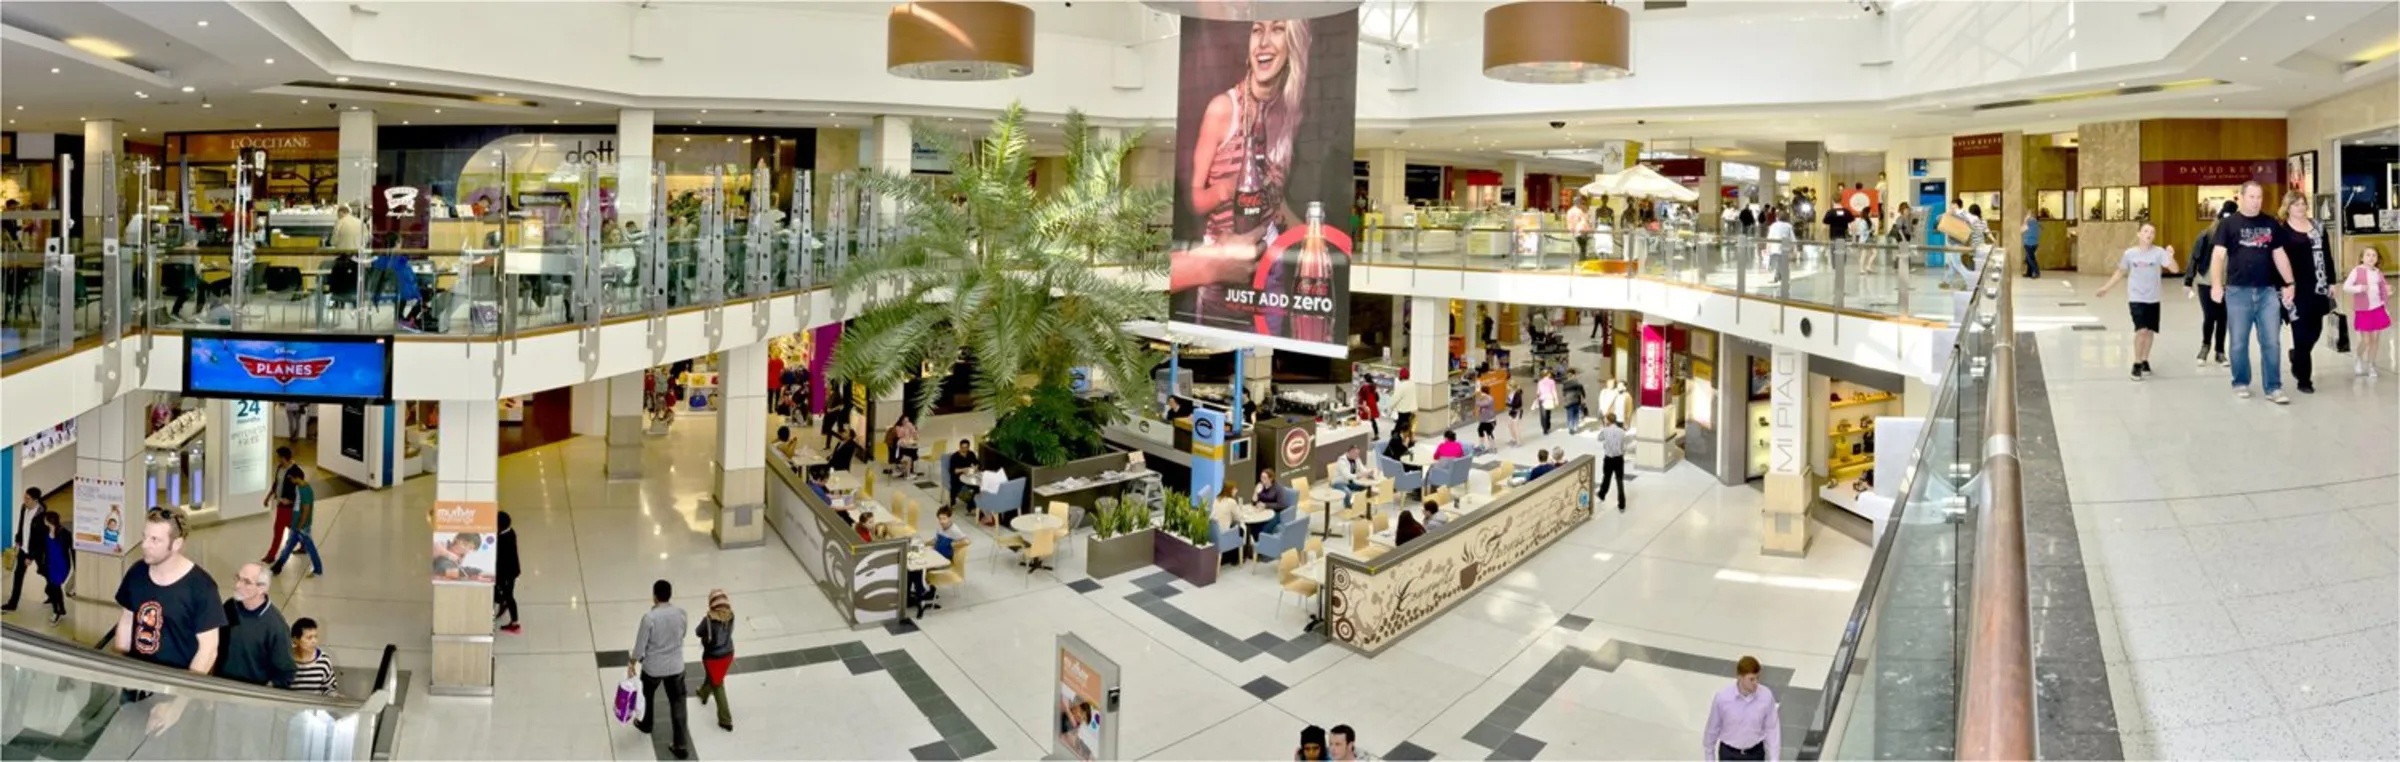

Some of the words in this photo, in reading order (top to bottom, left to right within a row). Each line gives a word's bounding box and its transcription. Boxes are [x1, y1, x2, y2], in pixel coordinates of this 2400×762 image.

[231, 136, 311, 150] L'OCCITANE
[2180, 166, 2223, 174] DAVID
[1225, 288, 1255, 304] JUST
[1259, 292, 1289, 307] ADD
[1293, 295, 1333, 312] zero
[256, 362, 313, 376] PLANES
[237, 399, 261, 417] 24
